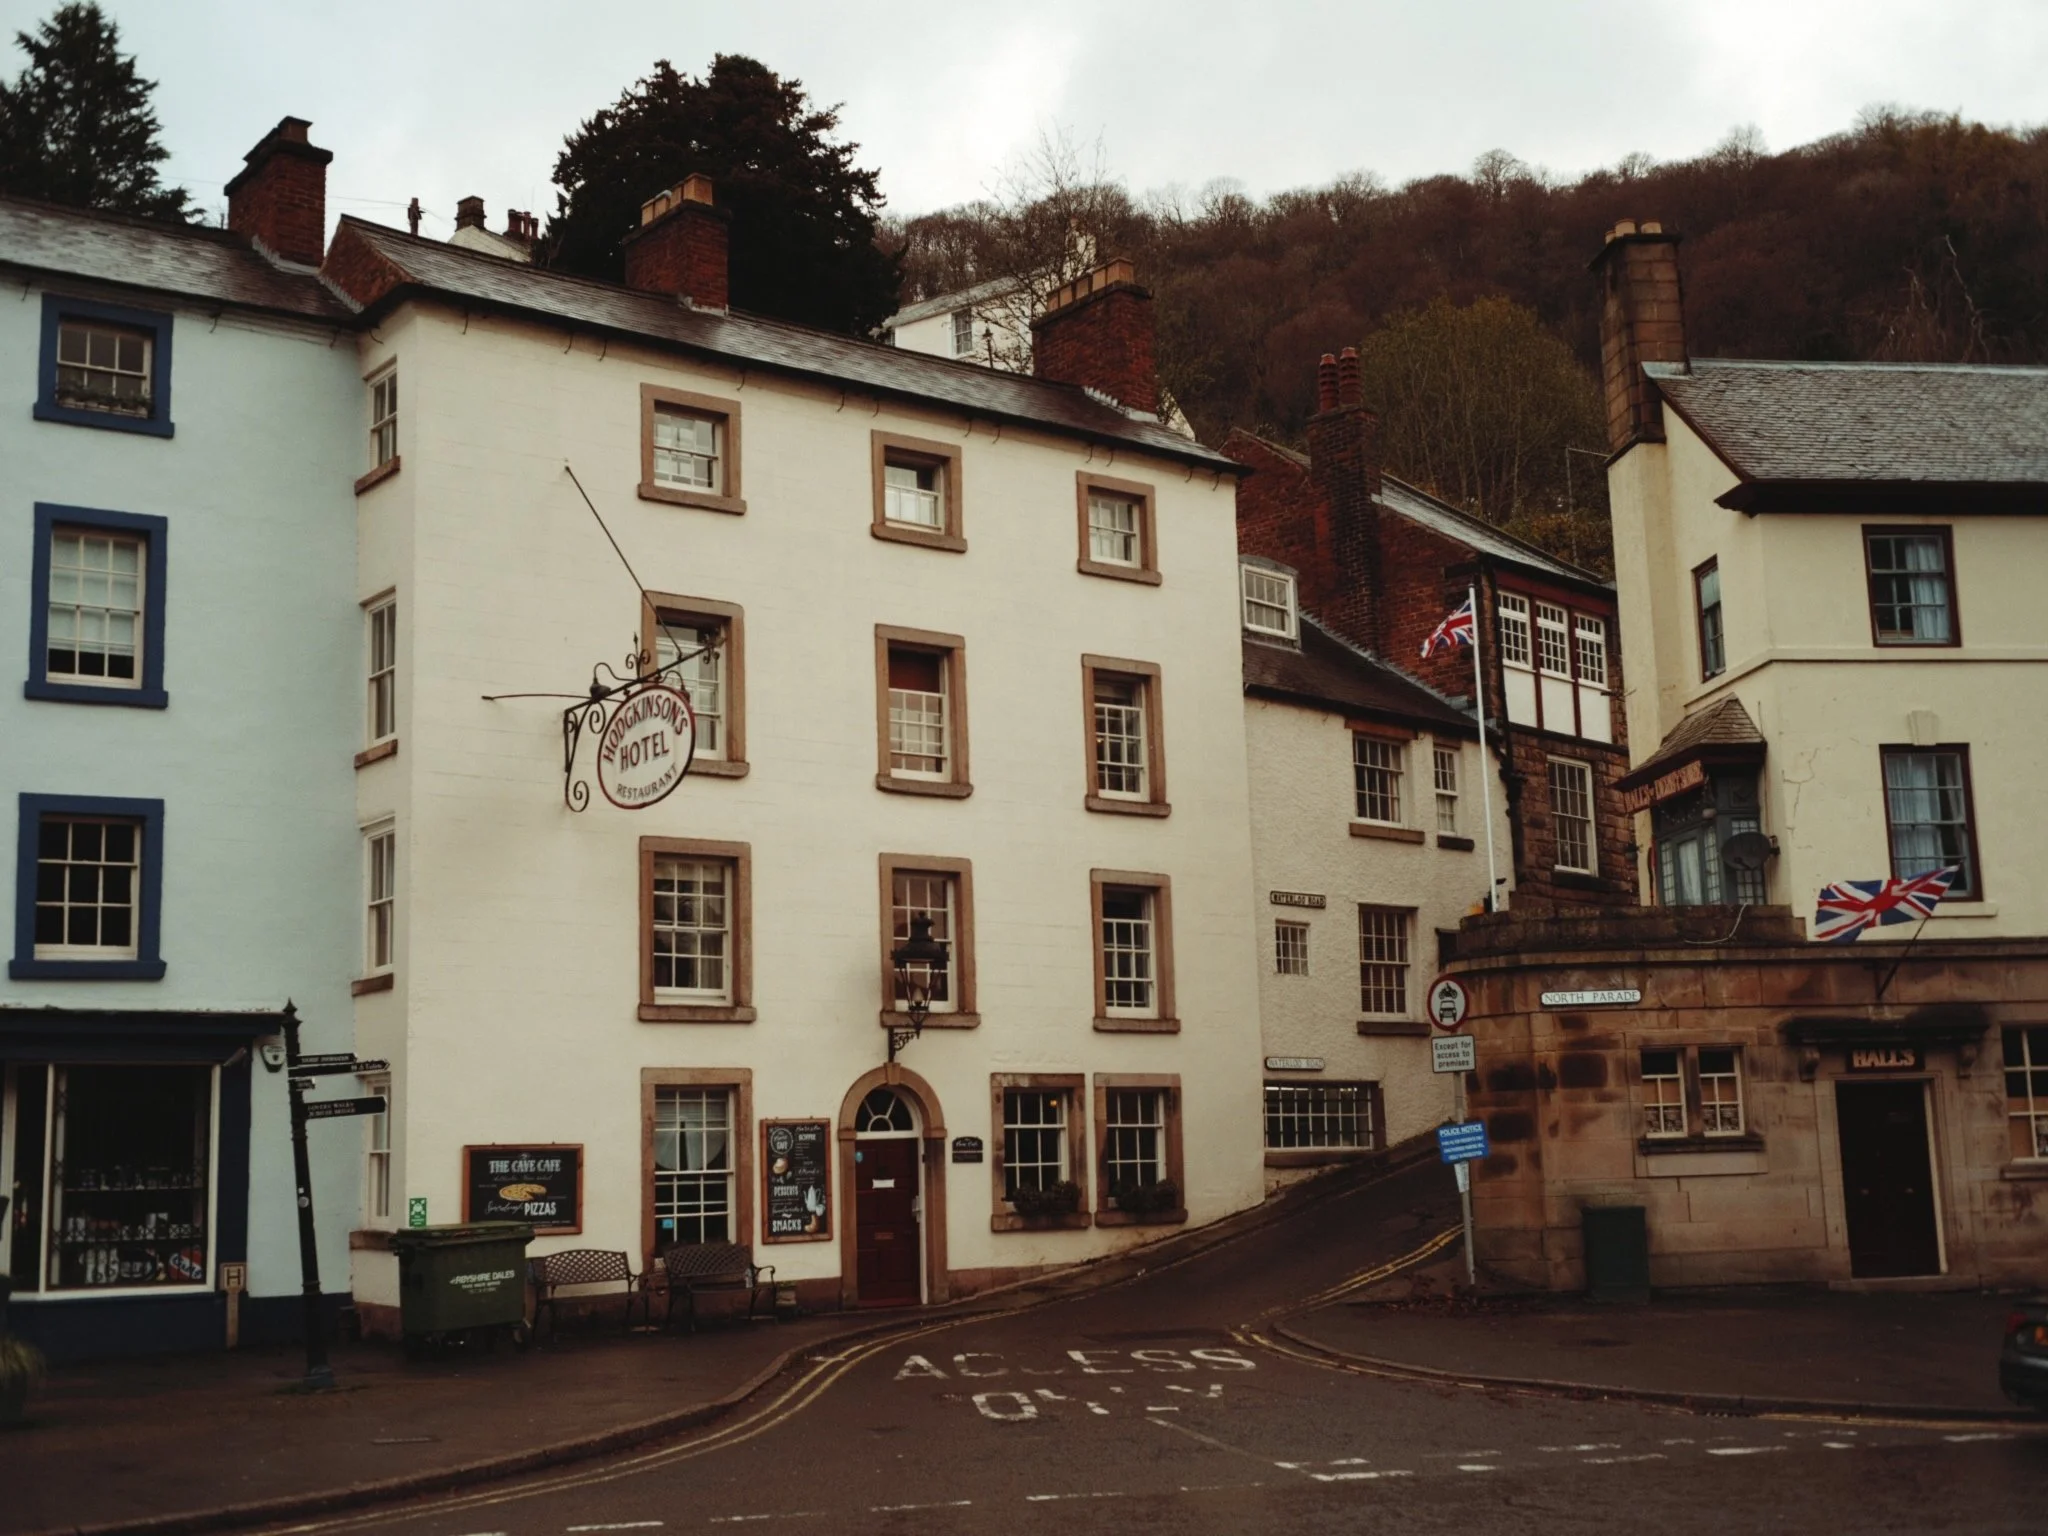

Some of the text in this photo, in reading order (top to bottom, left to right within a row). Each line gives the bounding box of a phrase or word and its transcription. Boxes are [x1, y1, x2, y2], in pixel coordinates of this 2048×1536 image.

[603, 694, 688, 763] HODGKINSON'S
[620, 731, 669, 773] HOTEL
[616, 763, 678, 800] RESTAURANT
[1273, 893, 1325, 906] WATERLOO ROAD
[1544, 990, 1638, 1003] NORTH PARADE
[1435, 1041, 1471, 1051] Except for
[1269, 1059, 1323, 1068] WATERLOO ROAD
[1438, 1060, 1469, 1069] premises
[1440, 1124, 1482, 1137] POLICE NOTICE
[489, 1159, 561, 1174] THE CAVE CAFE
[525, 1201, 556, 1216] PIZZAS
[772, 1219, 802, 1232] SNACKS
[492, 1269, 515, 1280] DALES
